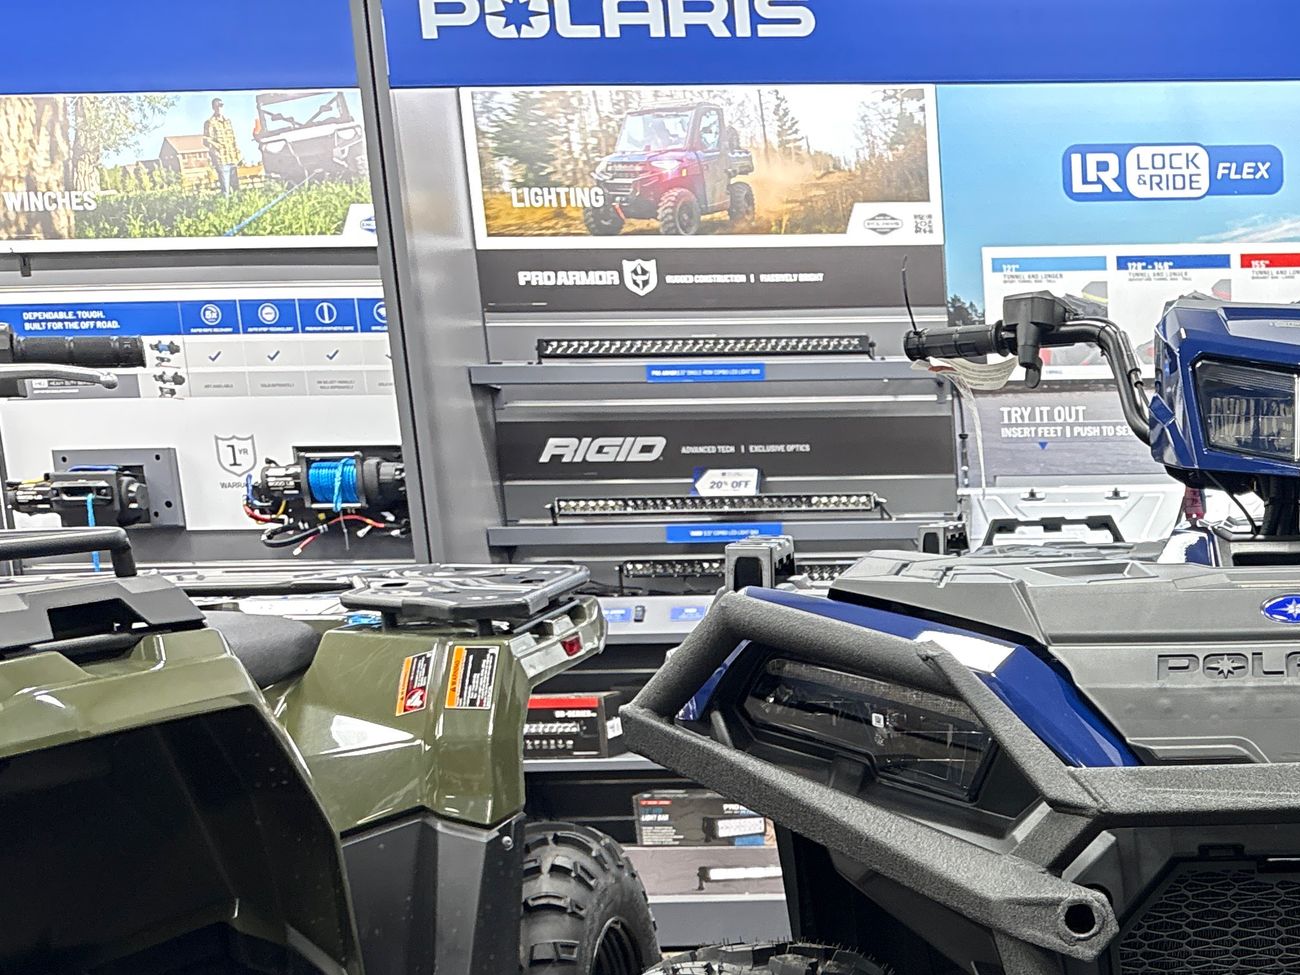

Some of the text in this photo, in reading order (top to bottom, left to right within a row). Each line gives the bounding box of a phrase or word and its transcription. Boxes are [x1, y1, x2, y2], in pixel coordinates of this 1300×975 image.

[420, 0, 816, 39] POLARIS
[1136, 152, 1201, 170] LOCK
[1216, 162, 1271, 180] FLEX
[3, 190, 98, 212] WINCHES
[511, 187, 605, 208] LIGHTING
[23, 310, 106, 321] DEPENDABLE. TOUGH.
[24, 321, 121, 331] BUILT FOR THE OFF ROAD.
[1000, 405, 1087, 424] TRY IT OUT
[1001, 427, 1036, 438] INSERT
[1037, 426, 1063, 437] FEET
[1073, 425, 1100, 436] PUSH
[1100, 425, 1115, 436] TO
[226, 444, 242, 466] 1
[539, 436, 667, 463] RIGID
[717, 445, 736, 453] TECH
[786, 443, 811, 452] OPTICS
[731, 480, 752, 489] OFF
